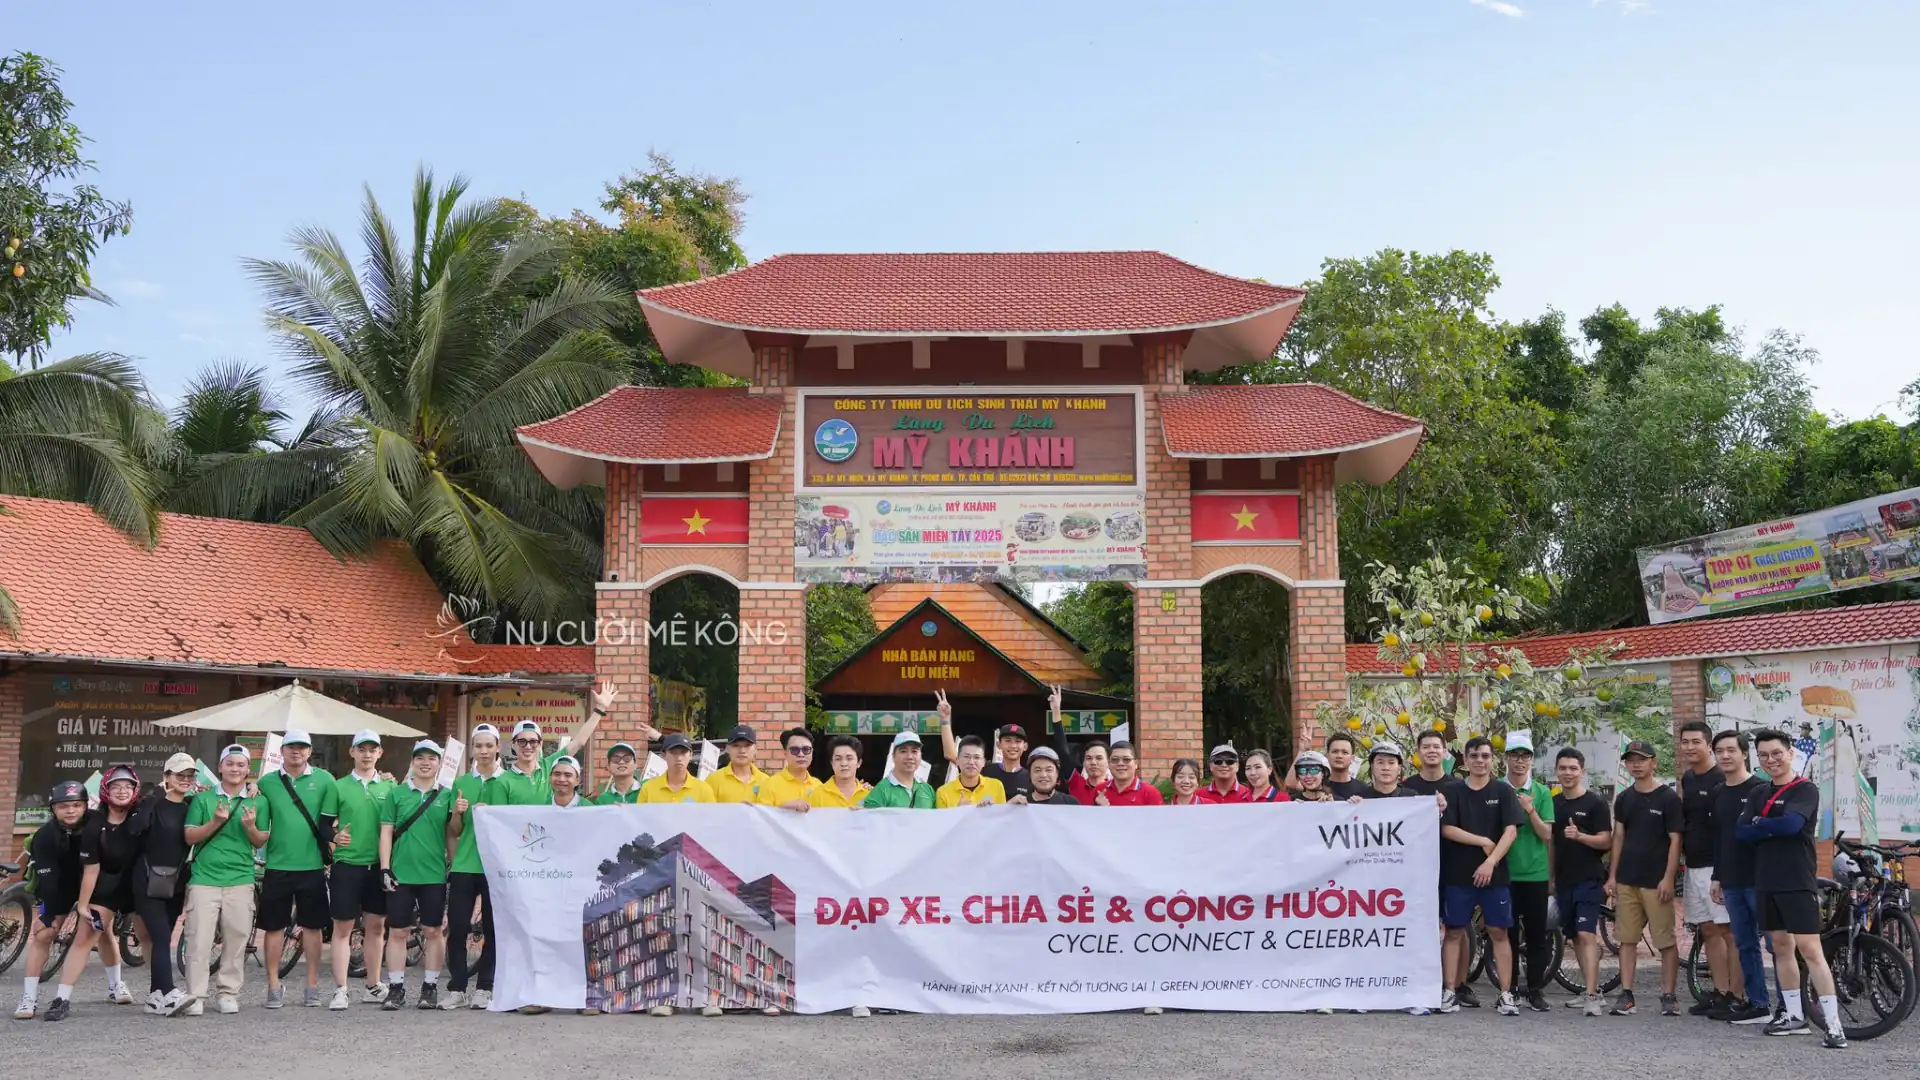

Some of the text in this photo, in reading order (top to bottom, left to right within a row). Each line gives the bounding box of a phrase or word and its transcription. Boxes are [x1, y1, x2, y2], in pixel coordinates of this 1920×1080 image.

[834, 397, 866, 410] CÔNG
[870, 399, 886, 410] TY
[890, 399, 922, 410] TNHH
[926, 399, 941, 410] DU
[977, 399, 1005, 410] SINH
[1010, 397, 1037, 410] THÁI
[873, 430, 1075, 468] MỸ KHÁNH
[945, 500, 960, 512] MỸ
[963, 499, 997, 512] KHÁNH
[974, 529, 1003, 543] 2025
[1708, 559, 1734, 576] TOP
[1736, 554, 1752, 571] 07
[1162, 599, 1176, 611] 02
[882, 647, 975, 662] NHÀ BÁN HÀNG
[901, 664, 960, 681] LƯU NIỆM
[57, 715, 84, 735] GIÁ
[89, 716, 107, 735] VÉ
[112, 718, 154, 736] THAM
[682, 857, 713, 891] WINK
[587, 882, 617, 907] WINK
[814, 879, 1405, 930] ĐẠP XE. CHIA SẺ & CỘNG HƯỞNG
[1048, 926, 1407, 954] CYCLE. CONNECT & CELEBRATE
[922, 980, 957, 993] HÀNH
[961, 981, 992, 994] TRÌNH
[995, 982, 1028, 994] XANH
[1037, 979, 1056, 993] KẾT
[1059, 979, 1081, 993] NỐI
[1131, 982, 1147, 993] LAI
[1161, 980, 1198, 992] GREEN
[1200, 979, 1252, 992] JOURNEY
[1262, 977, 1341, 990] CONNECTING
[1345, 977, 1365, 988] THE
[1368, 976, 1408, 988] FUTURE
